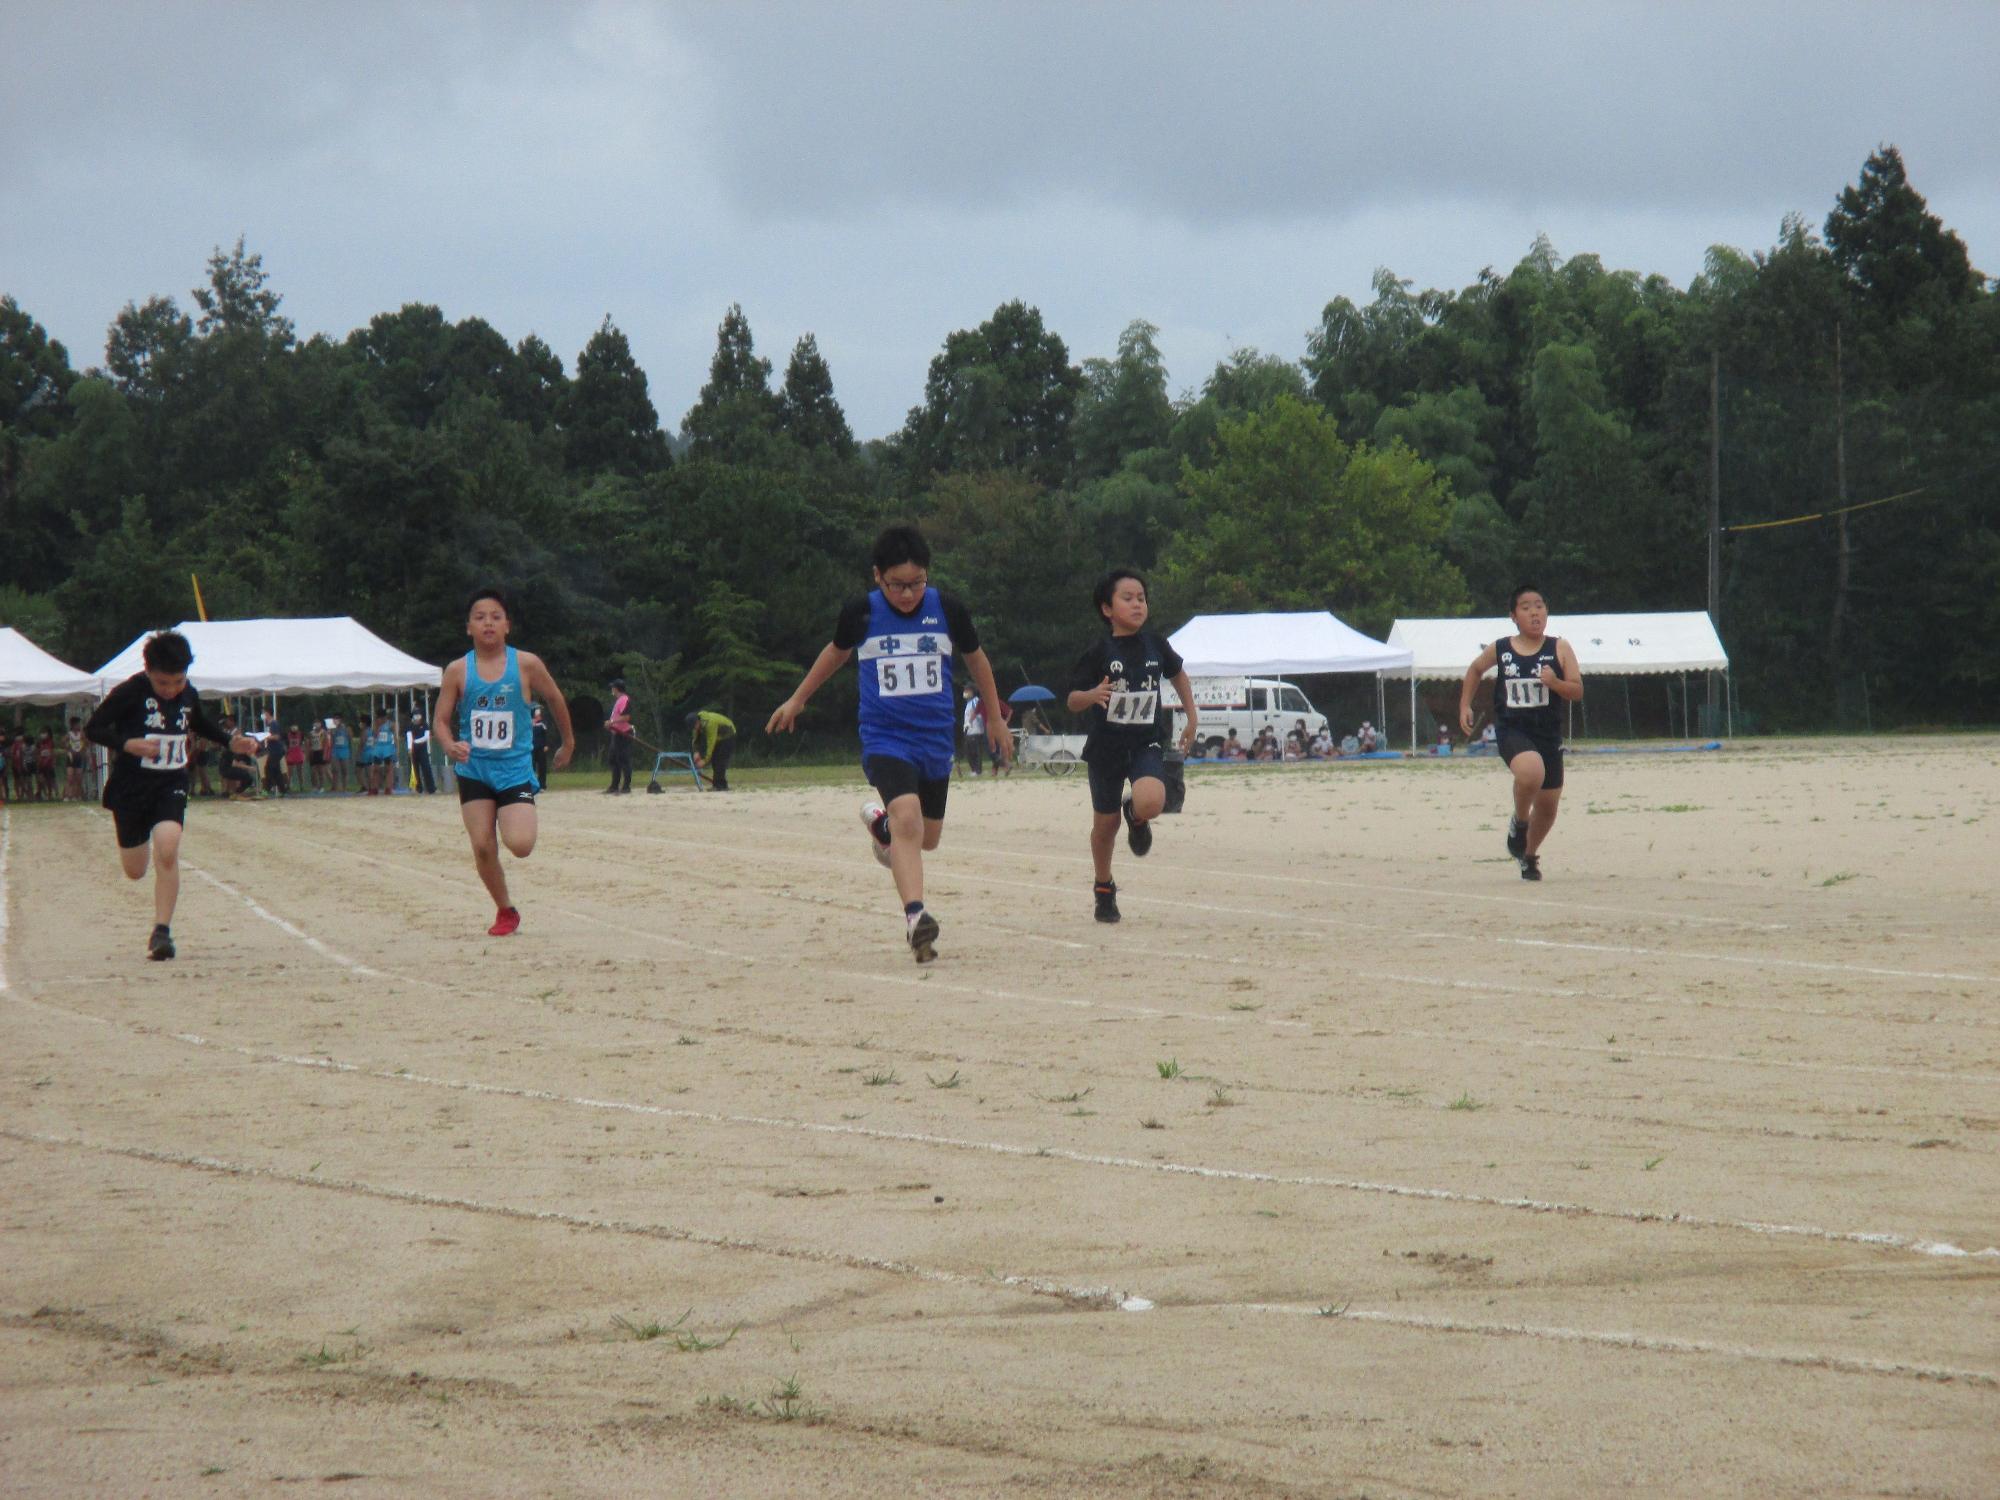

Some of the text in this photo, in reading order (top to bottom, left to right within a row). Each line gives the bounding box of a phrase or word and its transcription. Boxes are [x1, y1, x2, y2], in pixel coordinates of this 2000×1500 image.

[880, 635, 937, 654] 中条
[883, 661, 938, 691] 515
[1511, 683, 1543, 704] 417
[1113, 695, 1153, 720] 414
[475, 719, 507, 740] 818
